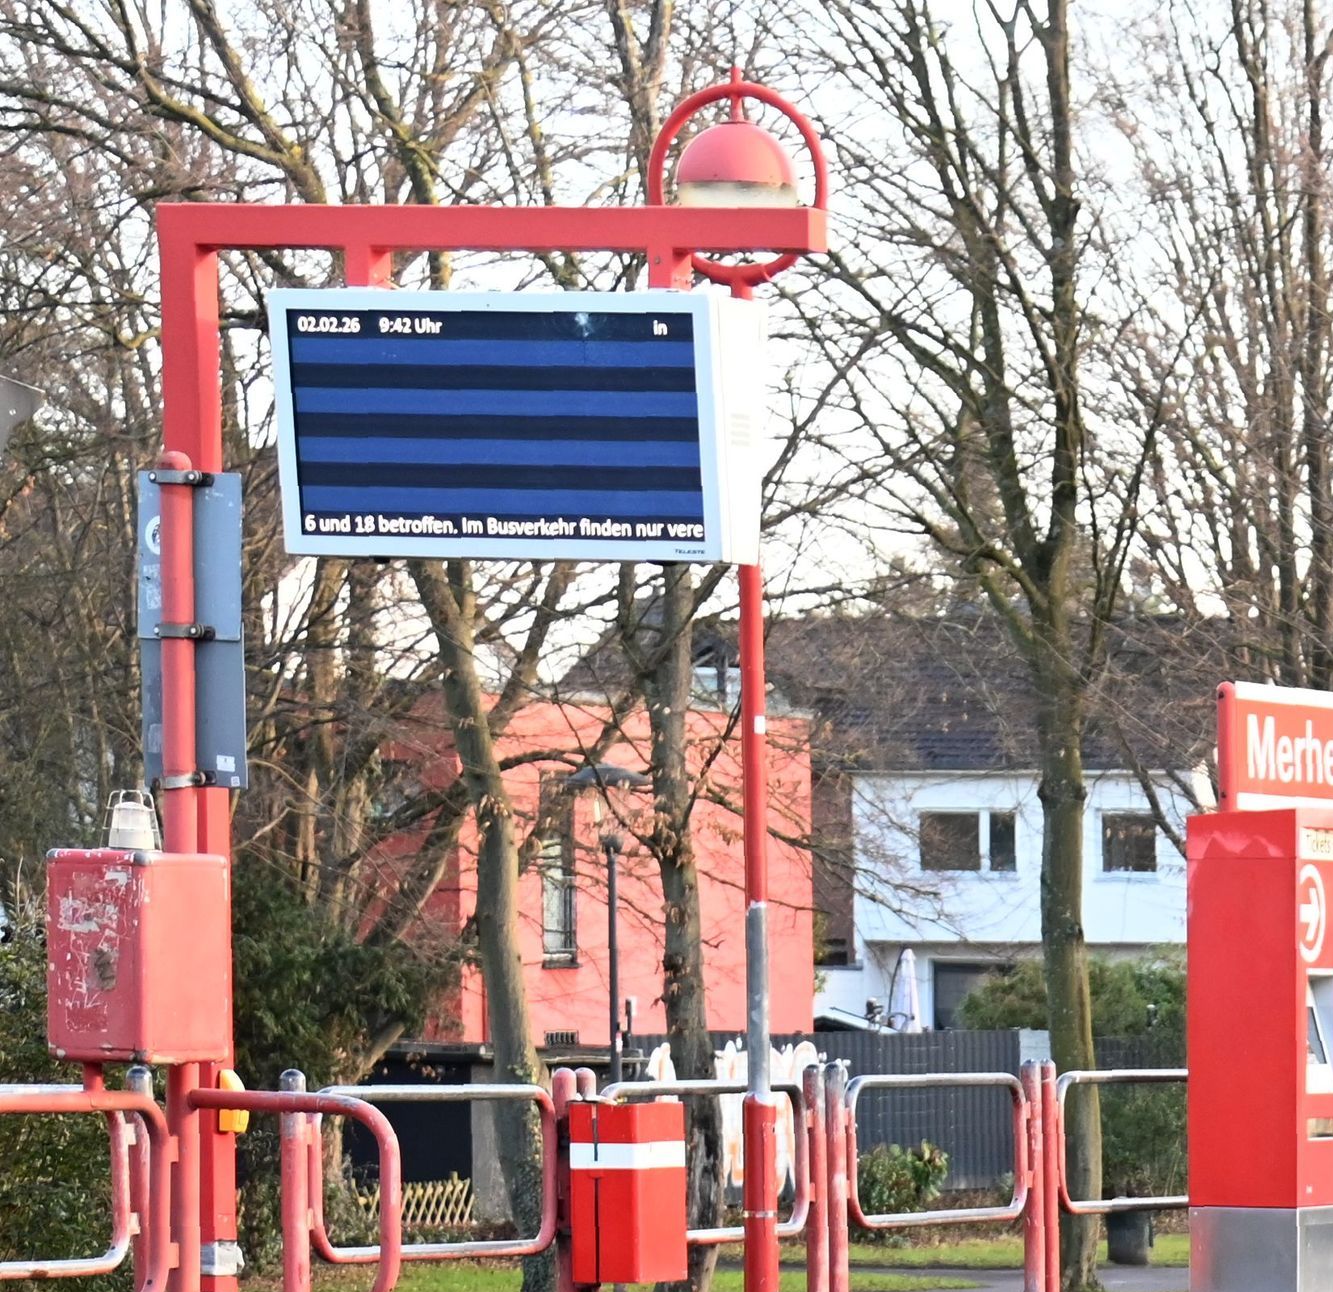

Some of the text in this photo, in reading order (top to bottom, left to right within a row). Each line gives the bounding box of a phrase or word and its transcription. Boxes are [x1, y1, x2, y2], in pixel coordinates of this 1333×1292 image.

[298, 316, 443, 334] 02.02.26 9:42 Uhr
[653, 319, 668, 336] in
[304, 514, 704, 539] 6 und 18 betroffen. Im Busverkehr finden nur vere
